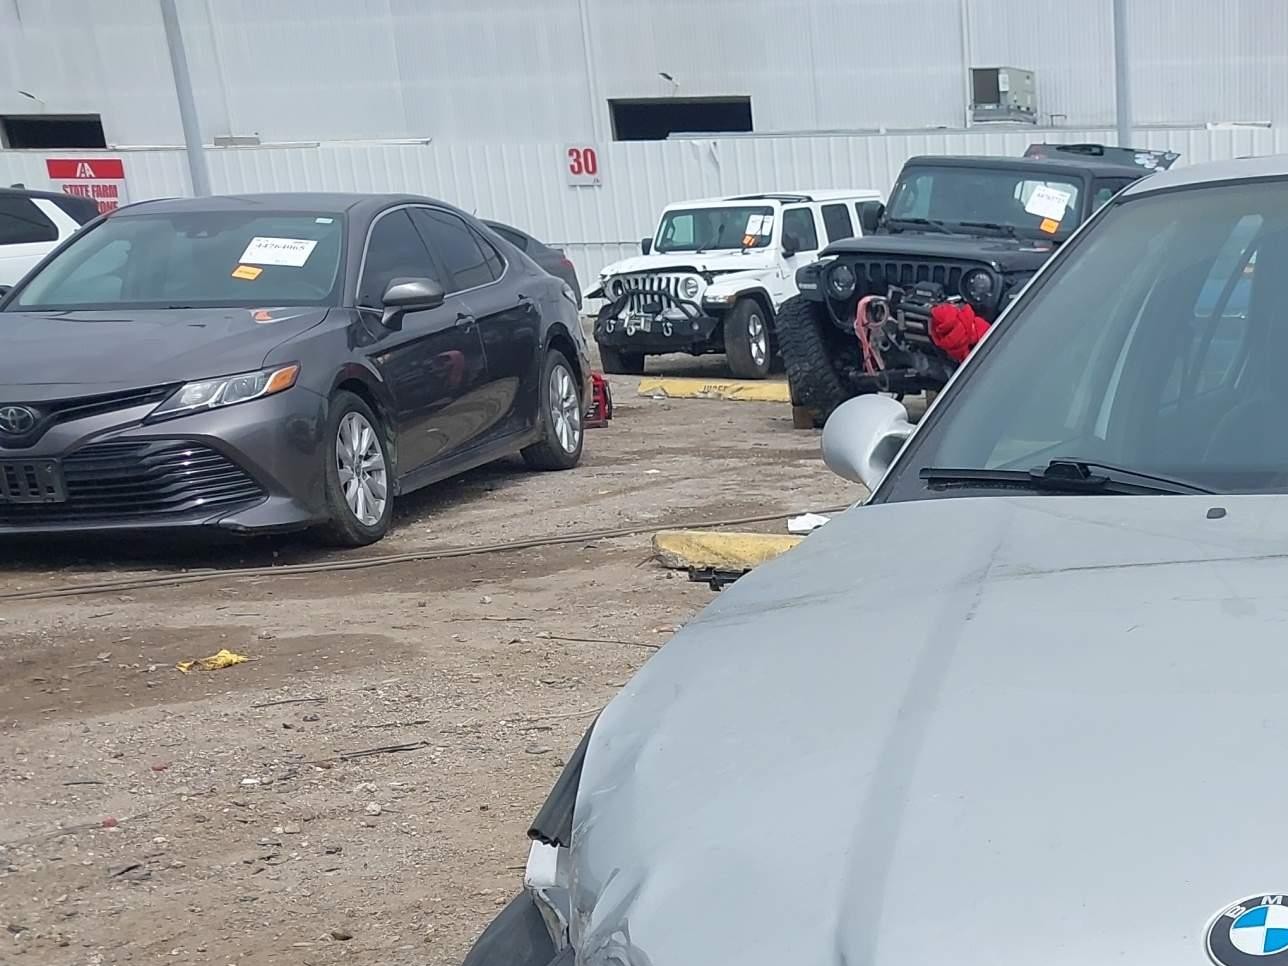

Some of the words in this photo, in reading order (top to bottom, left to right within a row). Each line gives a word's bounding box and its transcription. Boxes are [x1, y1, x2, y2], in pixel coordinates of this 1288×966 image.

[568, 148, 597, 175] 30
[62, 184, 89, 198] STATE
[91, 184, 118, 198] FARM
